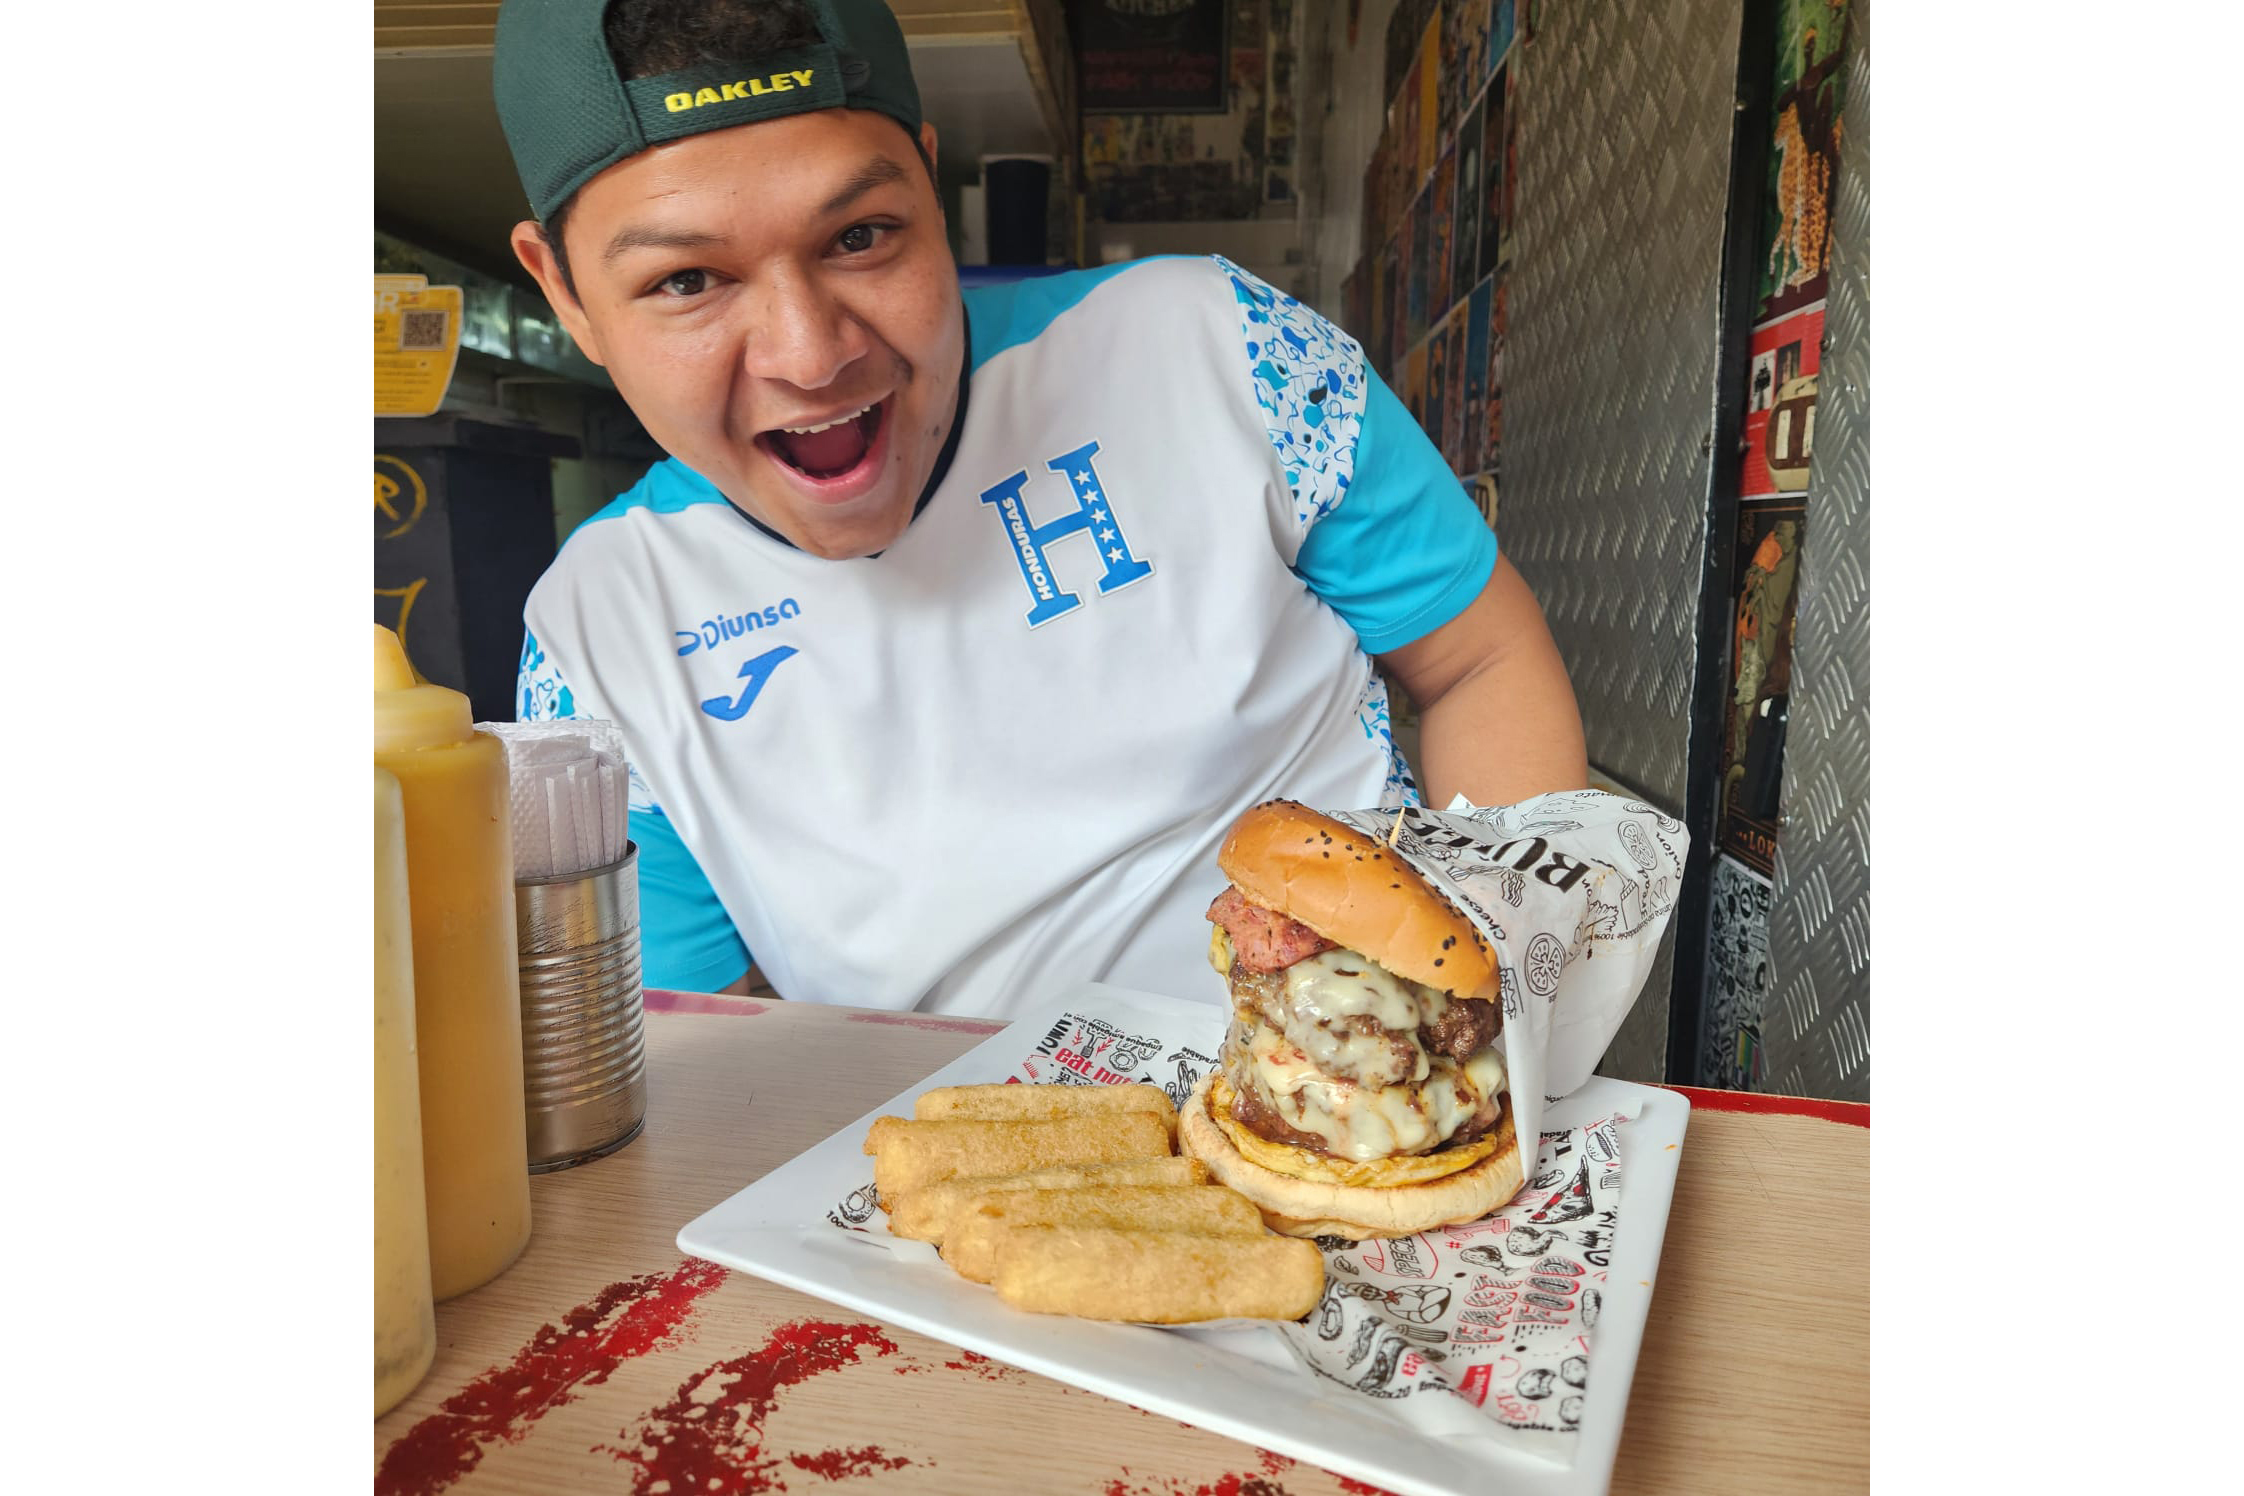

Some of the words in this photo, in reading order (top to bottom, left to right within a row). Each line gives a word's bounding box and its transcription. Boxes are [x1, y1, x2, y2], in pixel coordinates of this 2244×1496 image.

[664, 68, 815, 113] OAKLEY
[1001, 496, 1054, 602] HONDURAS
[1654, 831, 1682, 880] Onion
[1459, 893, 1507, 941] Cheese
[1054, 1047, 1095, 1075] eat
